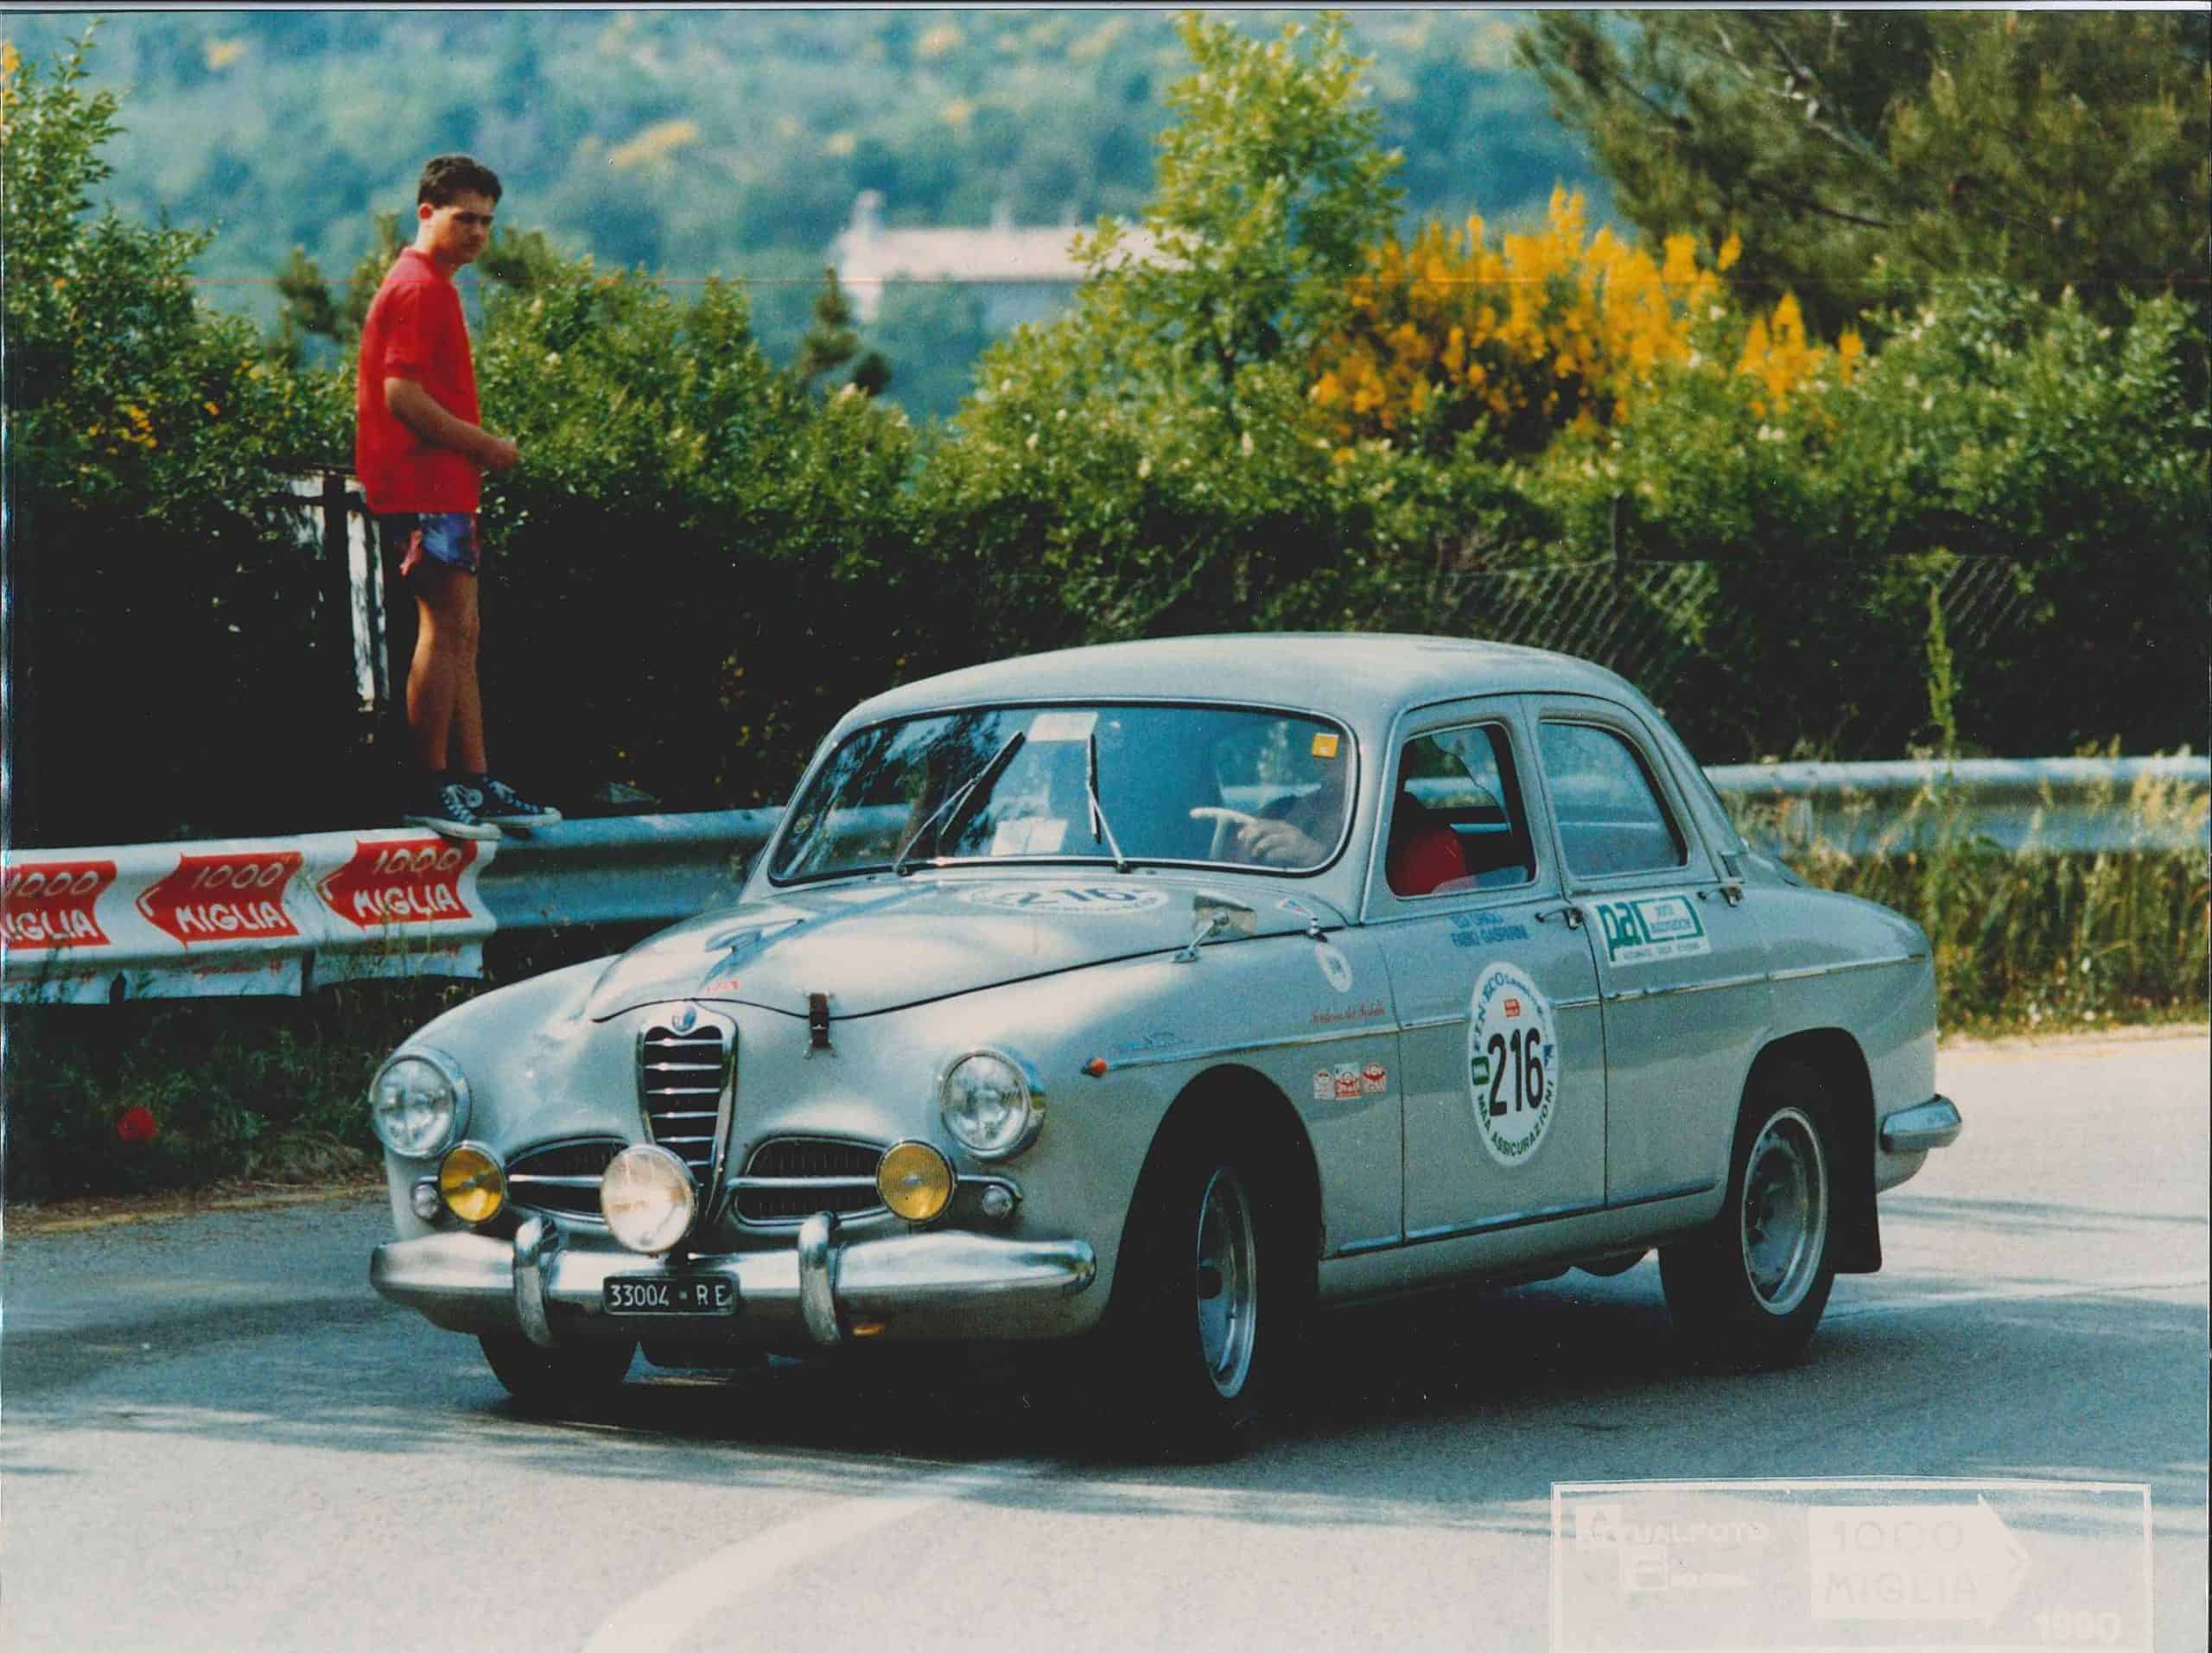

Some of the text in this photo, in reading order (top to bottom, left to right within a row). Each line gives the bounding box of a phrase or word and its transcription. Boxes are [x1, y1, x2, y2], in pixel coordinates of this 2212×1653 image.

[373, 847, 462, 874] 1000
[7, 870, 99, 898] 1000
[192, 862, 284, 890] 1000
[353, 883, 460, 919] MIGLIA
[175, 901, 288, 934] MIGLIA
[1487, 1027, 1544, 1117] 216
[1491, 1078, 1554, 1157] ASSICURAZIONI
[610, 1285, 728, 1307] 33004 RE
